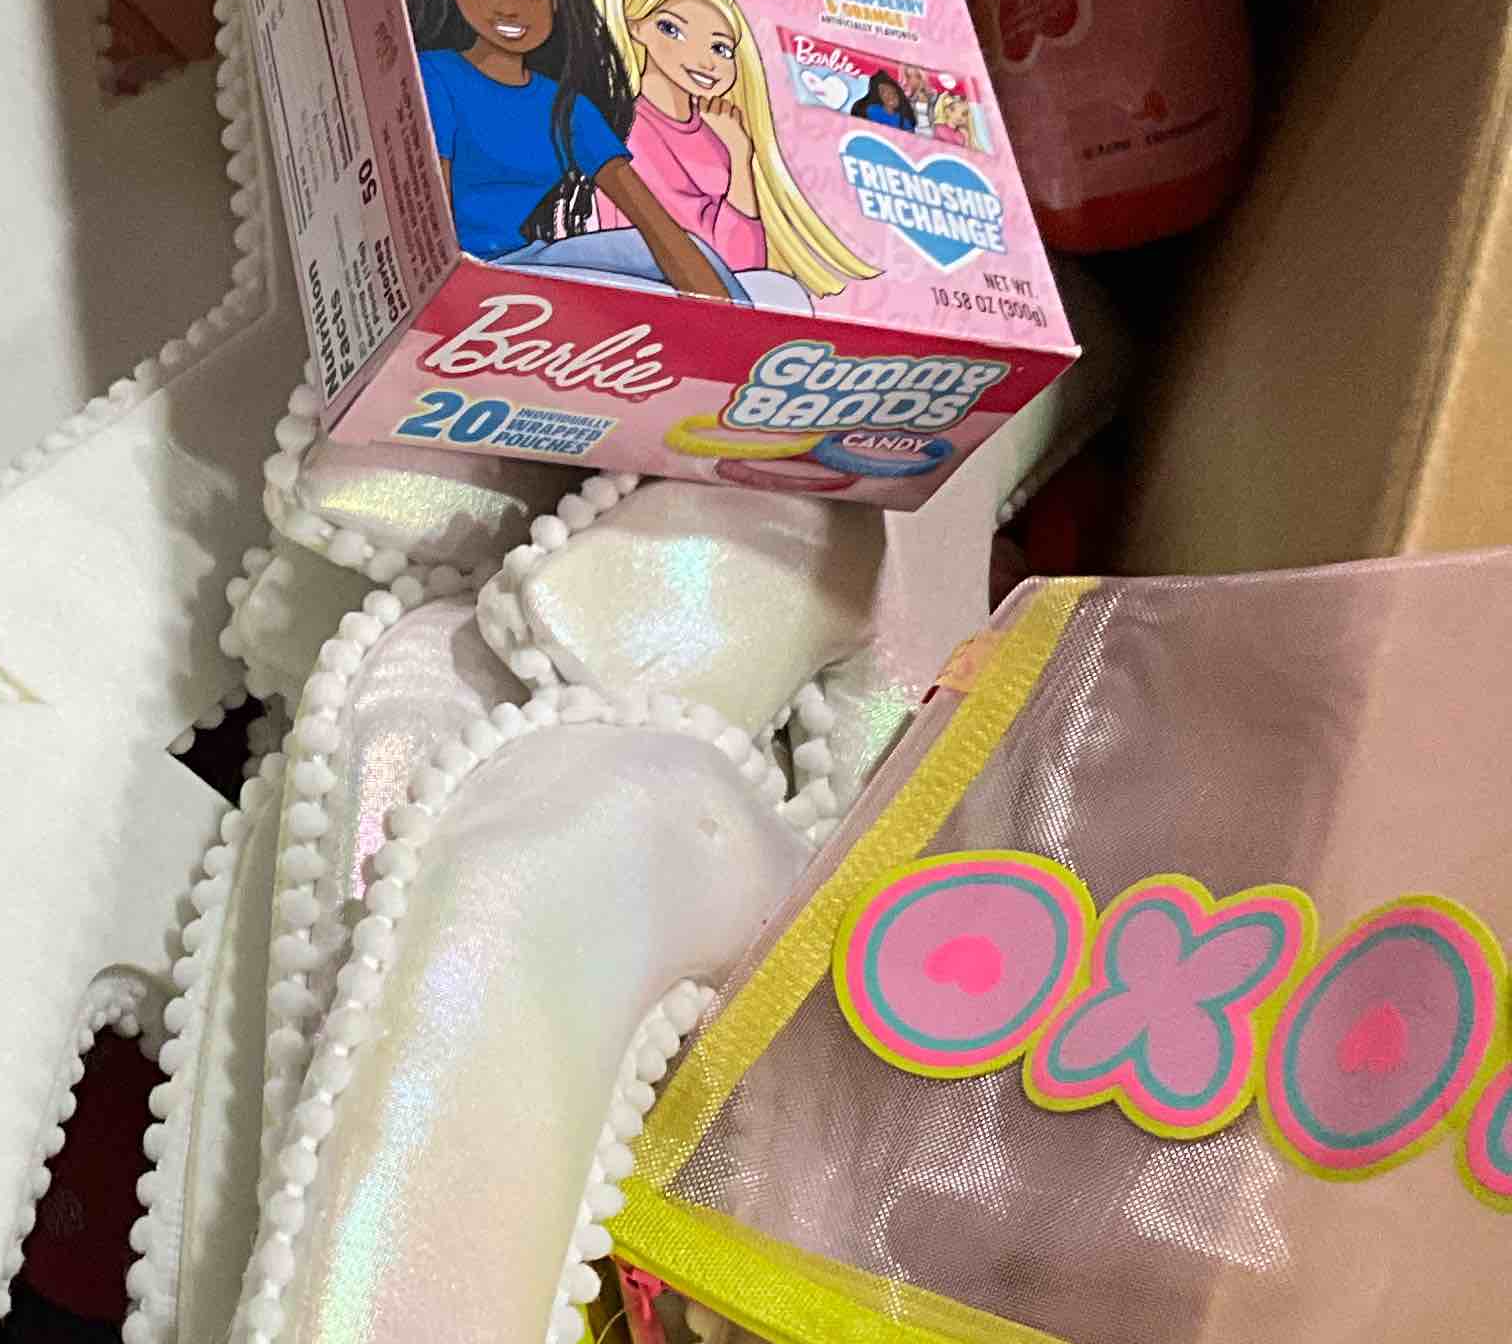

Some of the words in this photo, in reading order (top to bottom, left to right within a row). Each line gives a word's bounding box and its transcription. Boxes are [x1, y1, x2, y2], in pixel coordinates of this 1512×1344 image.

[841, 3, 904, 27] ORANGE
[794, 36, 864, 76] Barbie
[359, 158, 377, 205] 50
[843, 156, 1002, 222] FRIENDSHIP
[859, 189, 1004, 252] EXCHANGE
[375, 239, 398, 323] Calories
[984, 273, 1010, 293] NET
[931, 287, 972, 311] 10.58
[976, 296, 998, 314] OZ
[1000, 297, 1047, 327] (300g)
[308, 259, 340, 400] Nutrition
[330, 289, 355, 381] Facts
[424, 294, 674, 394] Barbie
[397, 390, 511, 443] 20
[504, 418, 603, 442] WRAPPED
[517, 407, 615, 430] INDIVIDUALLY
[491, 431, 589, 455] POUCHES
[842, 433, 935, 452] CANDY
